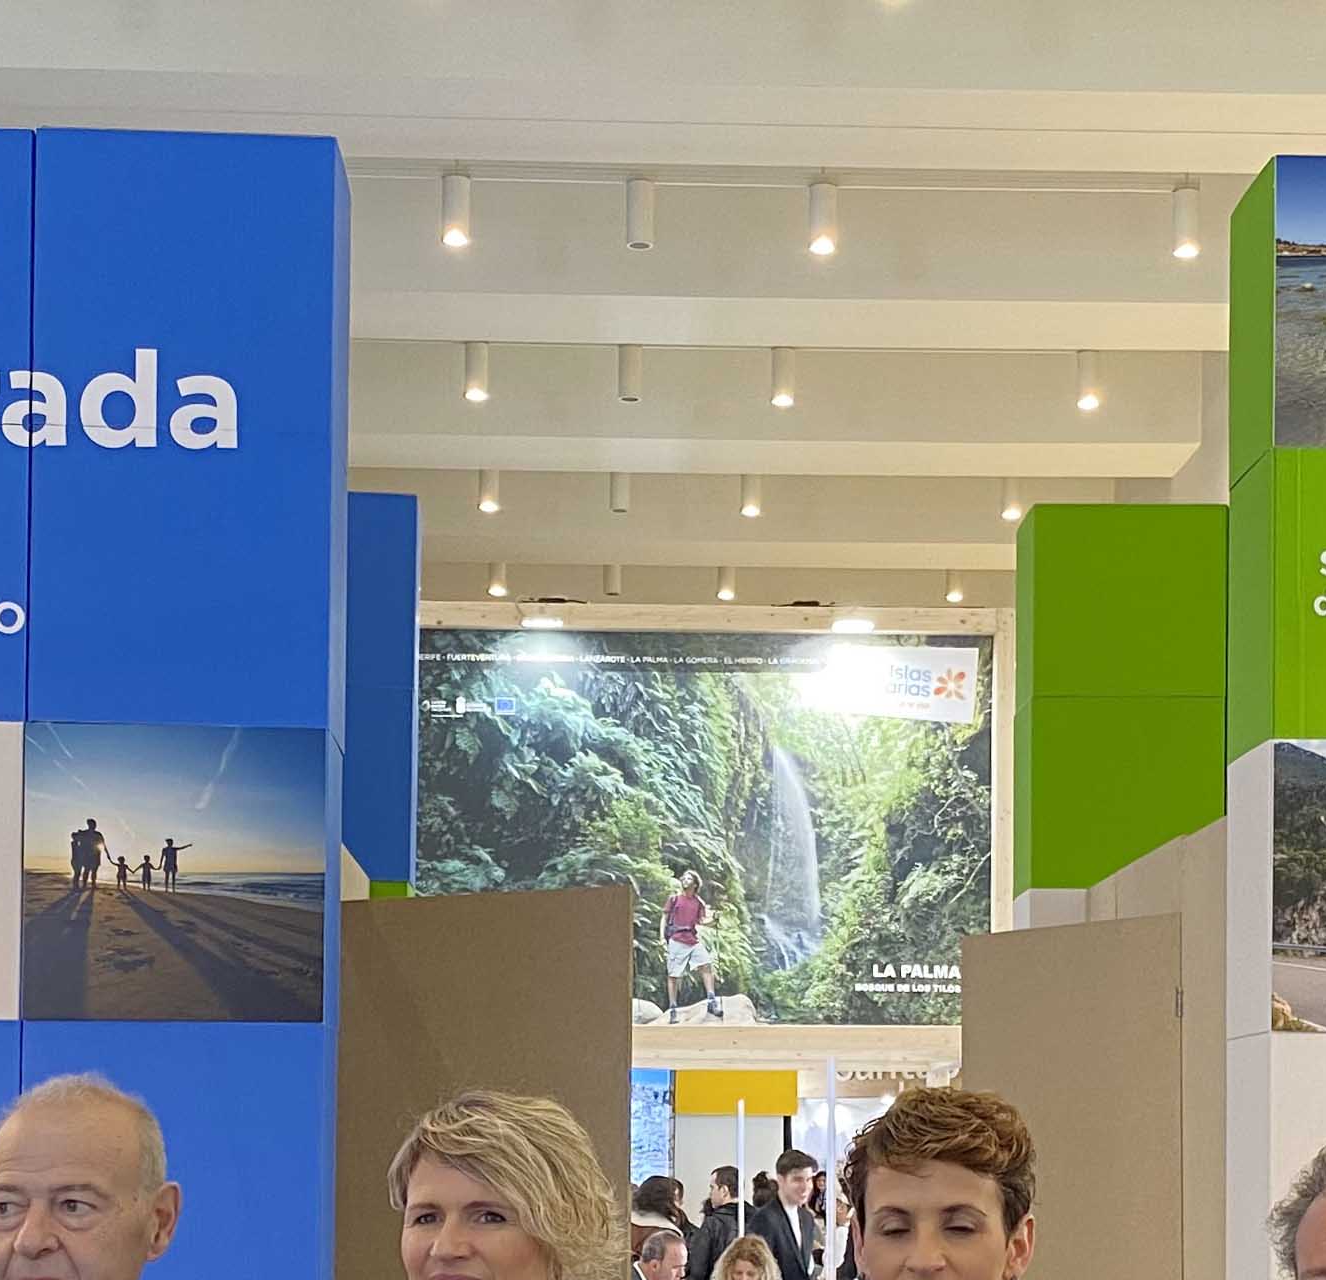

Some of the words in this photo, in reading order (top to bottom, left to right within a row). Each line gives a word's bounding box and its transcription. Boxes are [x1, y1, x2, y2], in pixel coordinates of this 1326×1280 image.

[872, 963, 896, 979] LA
[900, 964, 962, 979] PALMA
[854, 983, 895, 993] BOSQUE
[912, 984, 931, 993] LOS
[933, 984, 962, 994] TILOS
